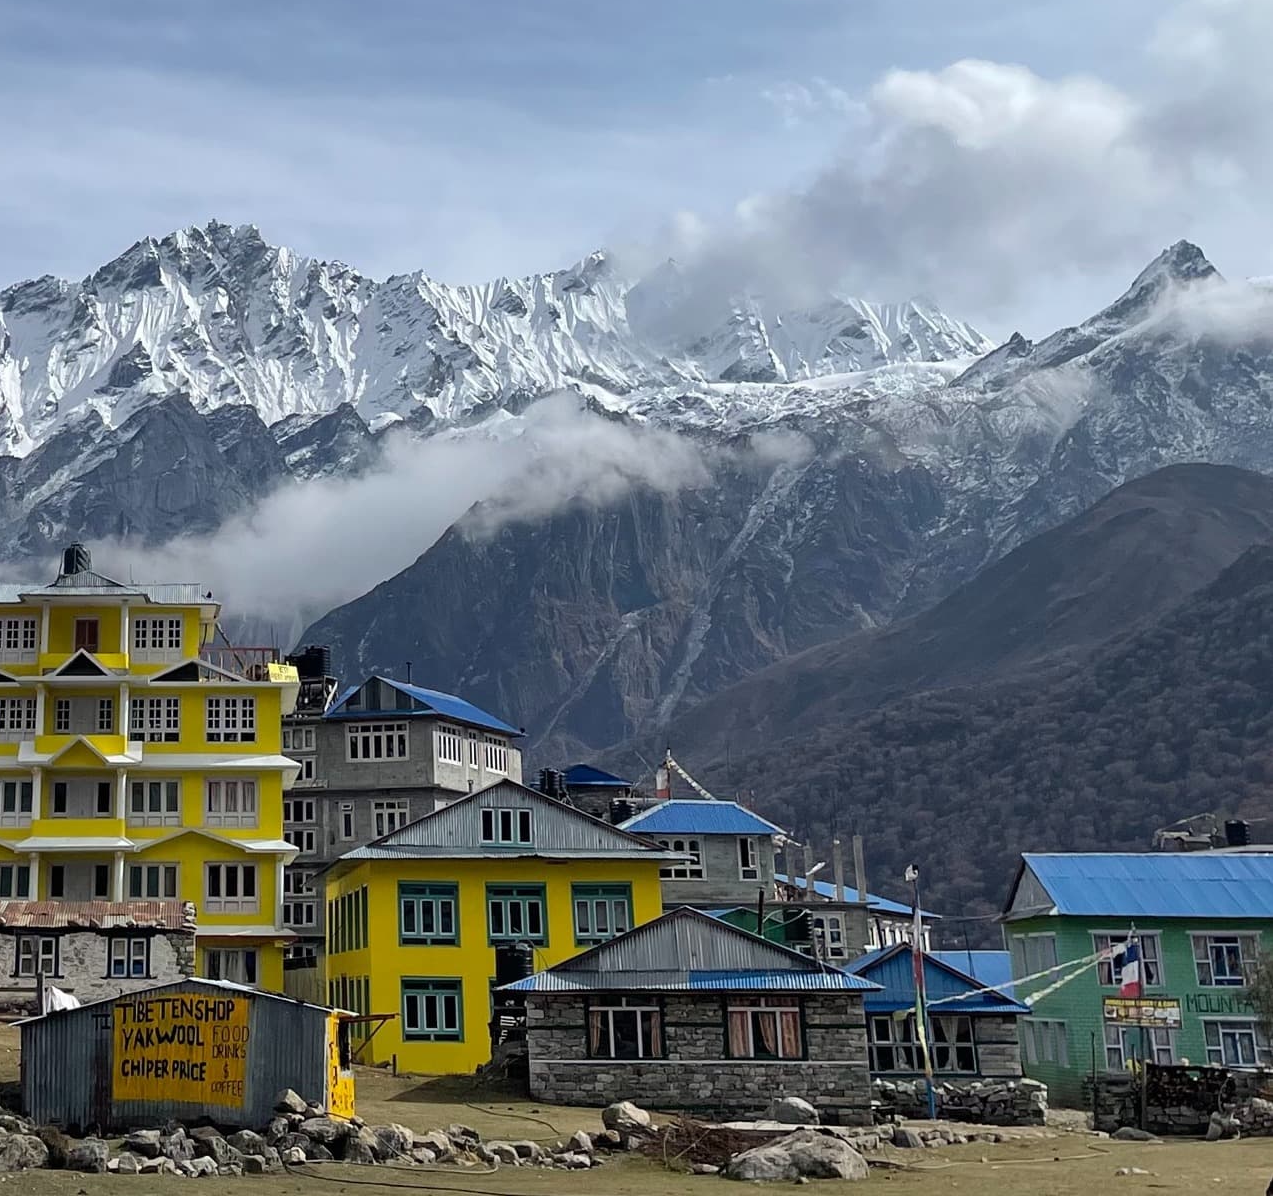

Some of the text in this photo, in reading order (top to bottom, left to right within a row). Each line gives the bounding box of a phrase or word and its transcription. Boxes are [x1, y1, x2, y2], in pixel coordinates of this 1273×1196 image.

[212, 1025, 250, 1044] FOOD
[212, 1043, 247, 1059] DRINKS
[121, 1057, 207, 1082] CHIPER PRICE
[211, 1079, 244, 1098] COFFEE
